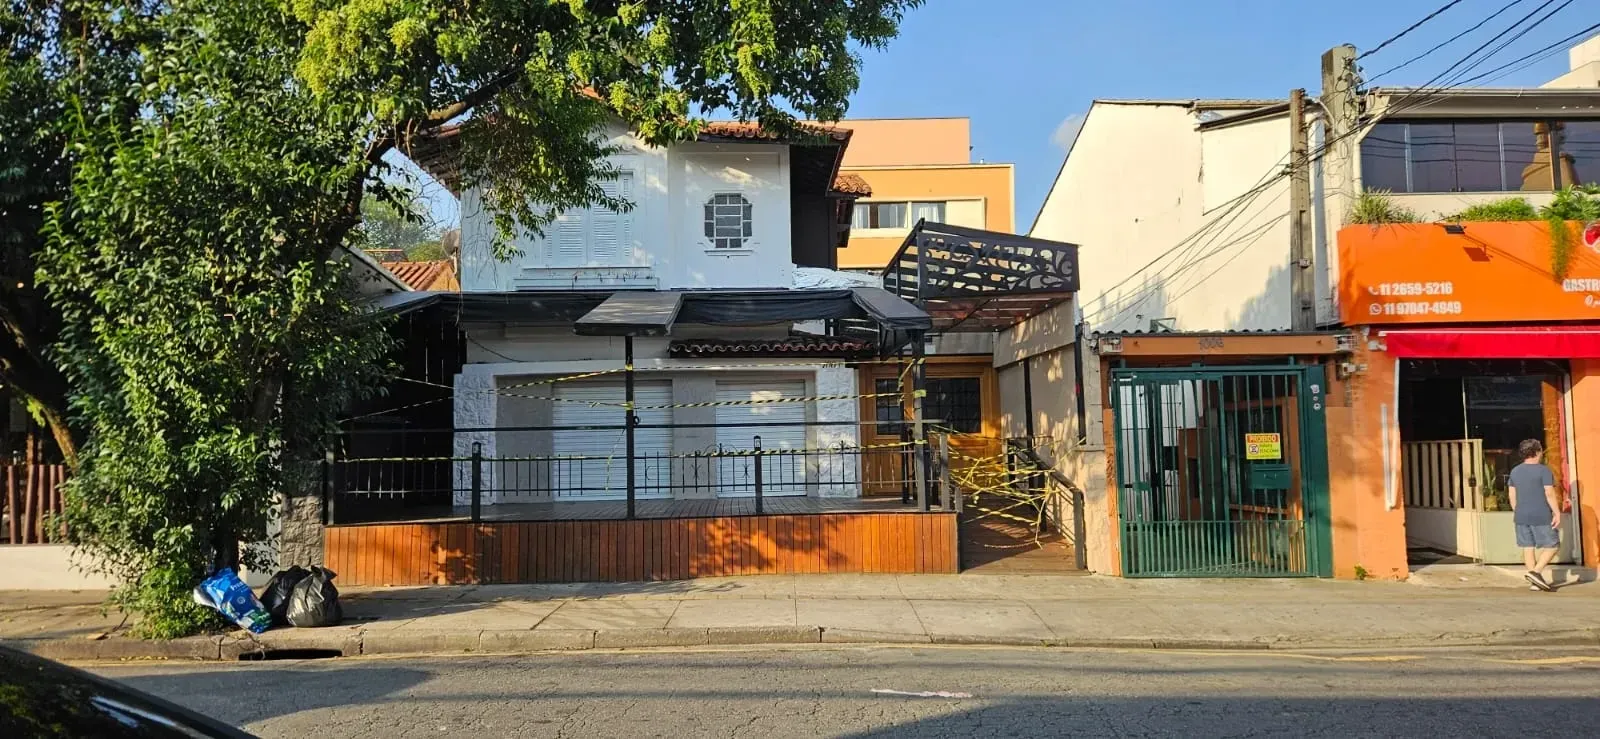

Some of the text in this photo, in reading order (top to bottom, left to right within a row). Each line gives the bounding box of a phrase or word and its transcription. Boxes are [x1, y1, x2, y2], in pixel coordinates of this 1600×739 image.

[1380, 281, 1453, 296] 11 2659-5216
[1562, 278, 1600, 292] GASTR
[1384, 301, 1462, 315] 11 97047-4949
